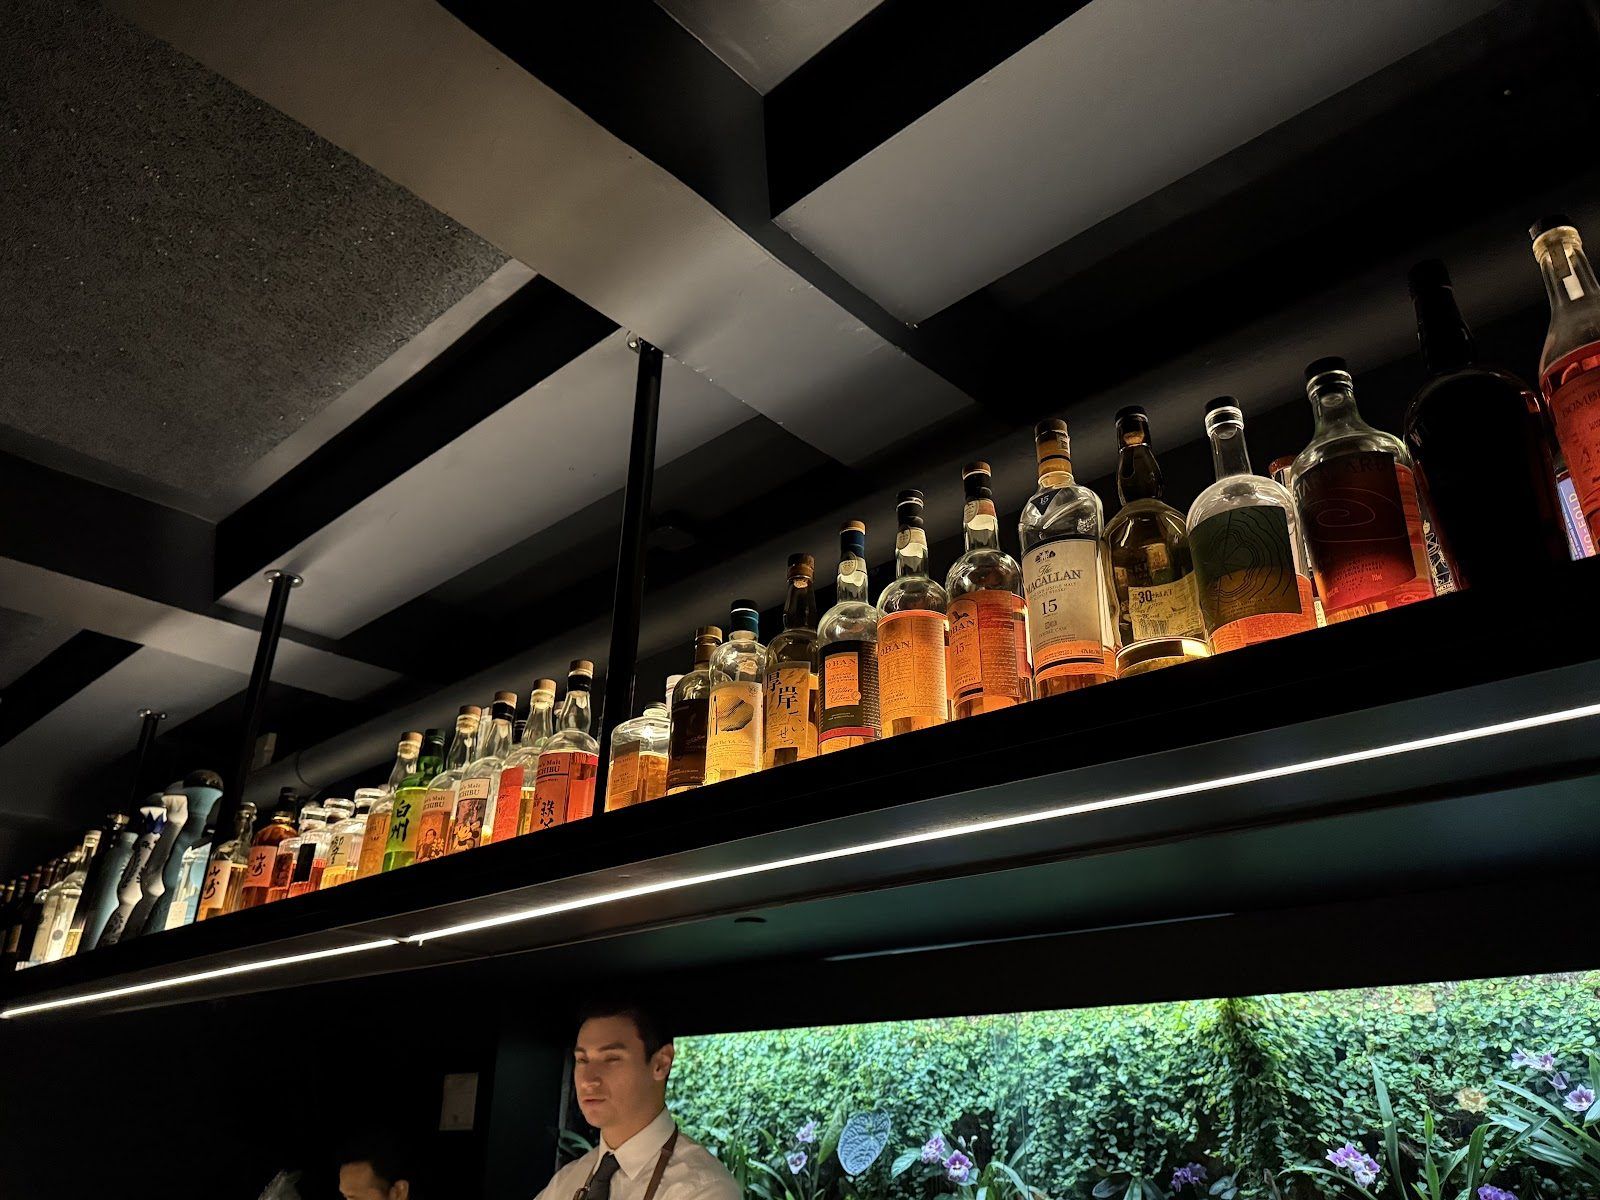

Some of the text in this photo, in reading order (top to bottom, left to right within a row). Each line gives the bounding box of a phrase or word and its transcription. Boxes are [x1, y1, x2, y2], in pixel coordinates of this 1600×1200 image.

[1040, 494, 1050, 505] 15
[1137, 590, 1153, 604] 30
[1041, 598, 1058, 616] 15
[390, 800, 412, 842] 白州
